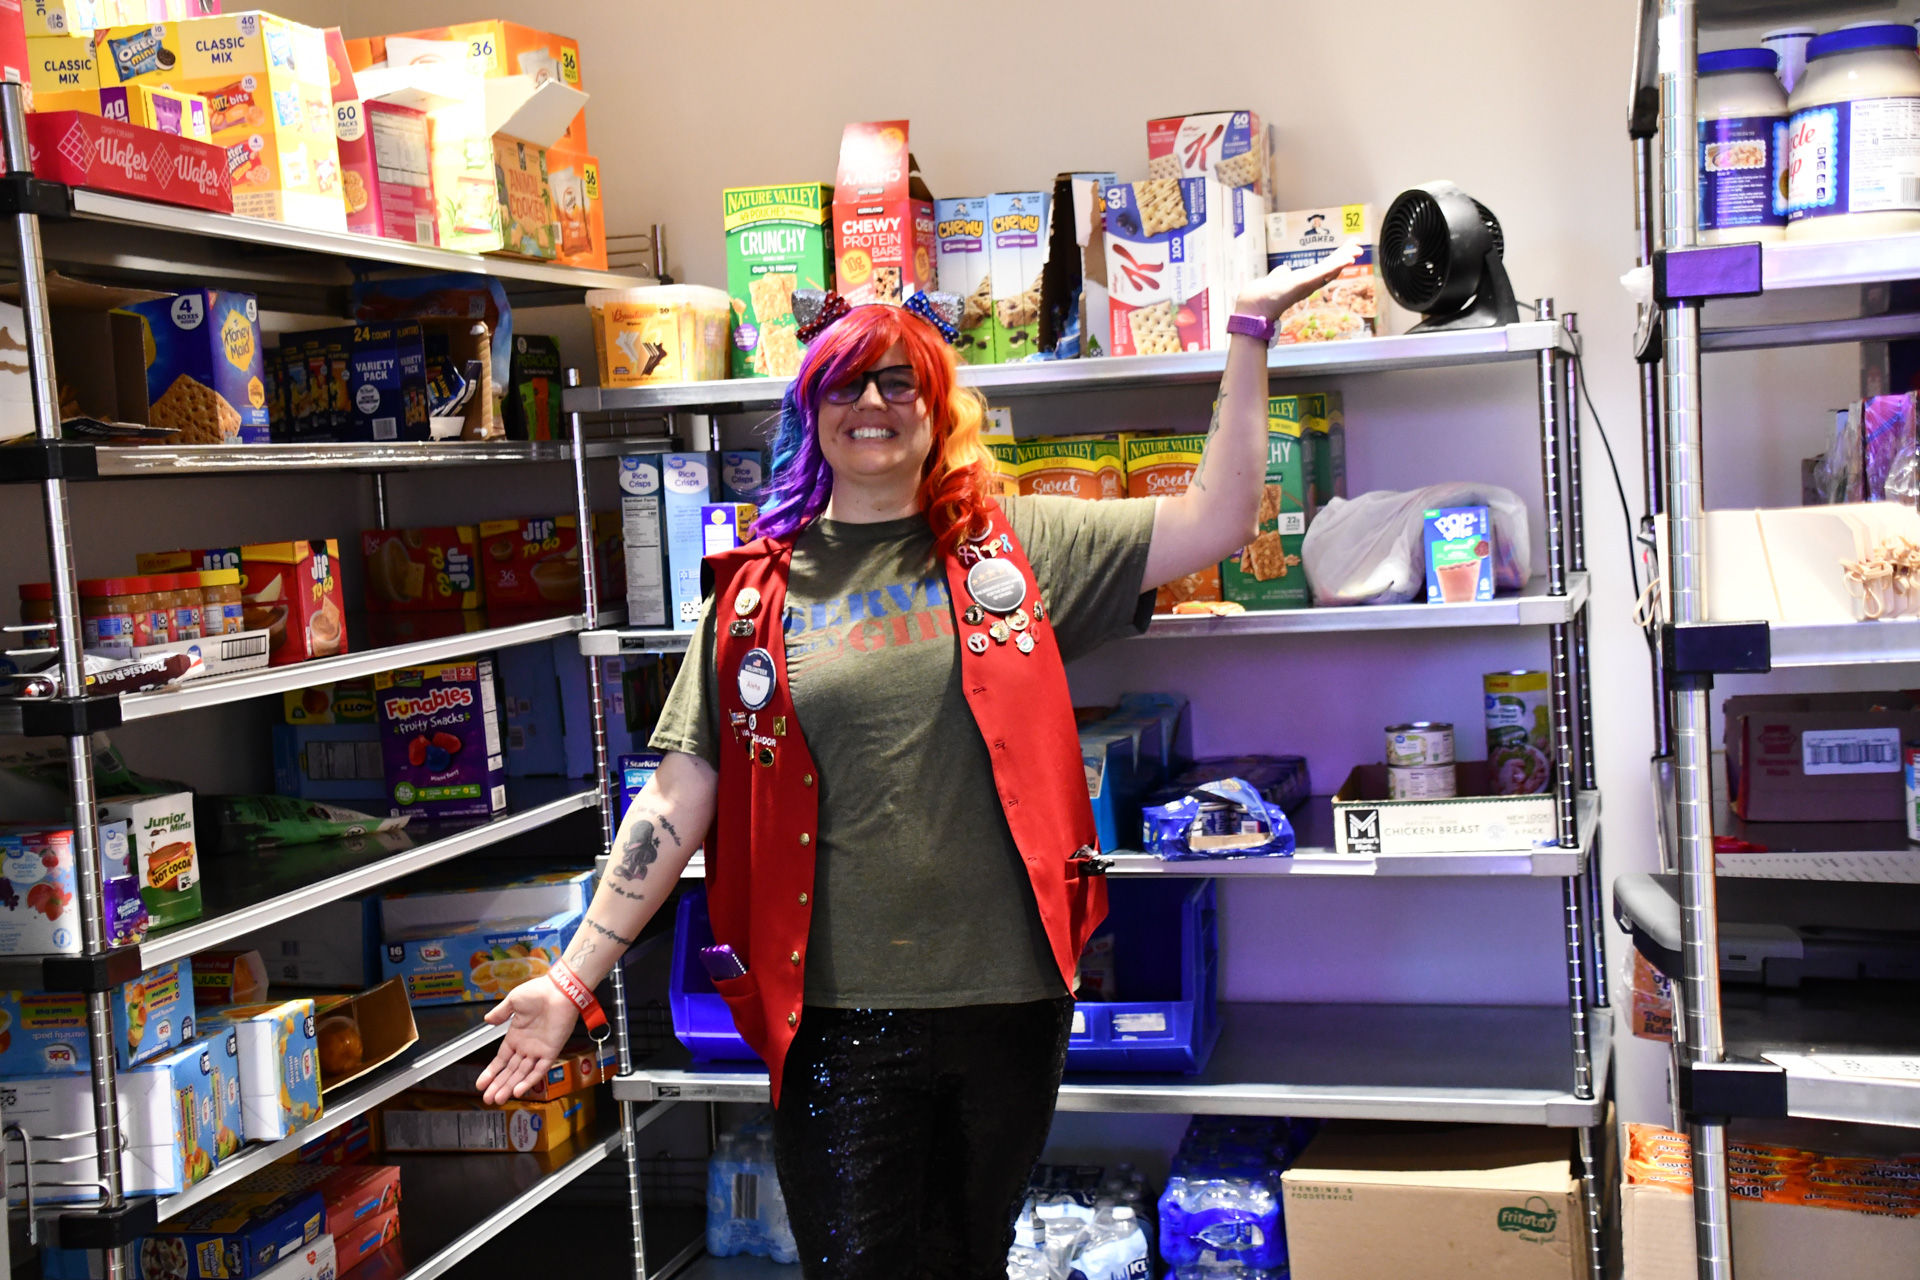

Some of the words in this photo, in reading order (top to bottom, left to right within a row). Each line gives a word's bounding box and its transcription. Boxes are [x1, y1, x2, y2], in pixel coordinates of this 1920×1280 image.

[241, 16, 255, 25] 40
[118, 38, 157, 62] OREO
[195, 36, 245, 52] CLASSIC
[471, 40, 493, 57] 36
[130, 47, 155, 67] mini
[211, 52, 233, 63] MIX
[562, 52, 576, 69] 36
[44, 59, 92, 72] CLASSIC
[58, 73, 79, 84] MIX
[103, 99, 125, 118] 40
[211, 95, 229, 112] RITZ
[229, 93, 249, 106] bits
[192, 110, 203, 126] 40
[337, 106, 356, 120] 60
[1233, 114, 1249, 125] 60
[95, 136, 150, 179] Wafer
[133, 172, 147, 182] BARS
[173, 154, 220, 194] Wafer
[585, 170, 596, 185] 36
[509, 169, 543, 198] ANIMAL
[727, 190, 774, 215] NATURE
[774, 186, 816, 207] VALLEY
[1107, 187, 1121, 210] 60
[509, 194, 546, 224] COOKIES
[750, 206, 786, 219] POUCHES
[842, 217, 901, 235] CHEWY
[1345, 213, 1360, 227] 52
[740, 228, 807, 256] CRUNCHY
[843, 232, 902, 249] PROTEIN
[1299, 235, 1335, 247] QUAKER
[871, 246, 902, 258] BARS
[1171, 237, 1182, 260] 100
[752, 265, 768, 274] Oats
[775, 264, 797, 273] Honey
[179, 298, 193, 314] 4
[176, 312, 199, 320] BOXES
[224, 325, 251, 348] Honey
[353, 326, 371, 342] 24
[371, 329, 391, 340] COUNT
[229, 341, 250, 359] Maid
[355, 359, 395, 372] VARIETY
[400, 354, 422, 367] VARIETY
[517, 354, 558, 368] PISTACHIOS
[363, 370, 388, 382] PACK
[404, 364, 419, 375] PACK
[1017, 445, 1056, 465] NATURE
[1056, 443, 1093, 460] VALLEY
[1130, 442, 1170, 460] NATURE
[1170, 439, 1206, 452] VALLEY
[1050, 457, 1069, 466] BARS
[631, 472, 648, 480] Rice
[677, 471, 696, 479] Rice
[734, 468, 750, 476] Rice
[629, 480, 652, 489] Crisps
[675, 479, 700, 487] Crisps
[731, 475, 754, 484] Crisps
[1032, 475, 1080, 495] Sweet
[1146, 470, 1192, 491] Sweet
[522, 520, 554, 541] Jif
[368, 537, 380, 553] 36
[523, 543, 540, 558] TO
[542, 538, 561, 550] GO
[203, 552, 239, 571] Jif
[311, 554, 330, 580] Jif
[447, 547, 471, 589] Jif
[500, 570, 516, 581] 36
[312, 582, 324, 601] TO
[323, 577, 334, 596] GO
[436, 572, 452, 598] GO
[849, 609, 955, 652] GIR
[459, 668, 473, 677] 22
[745, 664, 768, 676] VOLUNTEER
[385, 686, 474, 720] Funables
[430, 713, 465, 728] Snacks
[629, 760, 661, 769] StarKist
[446, 769, 460, 781] Berry
[627, 775, 643, 784] Light
[144, 813, 186, 830] Junior
[169, 820, 191, 833] Mints
[1384, 826, 1435, 837] CHICKEN
[1438, 824, 1480, 835] BREAST
[1347, 837, 1379, 846] Member's
[12, 862, 37, 870] Classic
[152, 870, 168, 887] HOT
[168, 858, 191, 875] COCOA
[517, 934, 539, 942] added
[389, 946, 403, 956] 16
[424, 949, 441, 957] Dole
[200, 975, 228, 986] JUICE
[60, 1018, 80, 1026] diced
[1643, 1010, 1672, 1027] Top
[159, 1025, 169, 1035] Dole
[182, 1027, 192, 1038] 16
[307, 1017, 315, 1036] 20
[32, 1031, 53, 1041] pack
[54, 1031, 86, 1040] variety
[229, 1037, 237, 1053] 16
[49, 1051, 70, 1062] Dole
[203, 1054, 210, 1071] 16
[1290, 1185, 1340, 1193] VENDING
[1290, 1193, 1354, 1202] FOODSERVICE
[207, 1243, 219, 1277] Shredded
